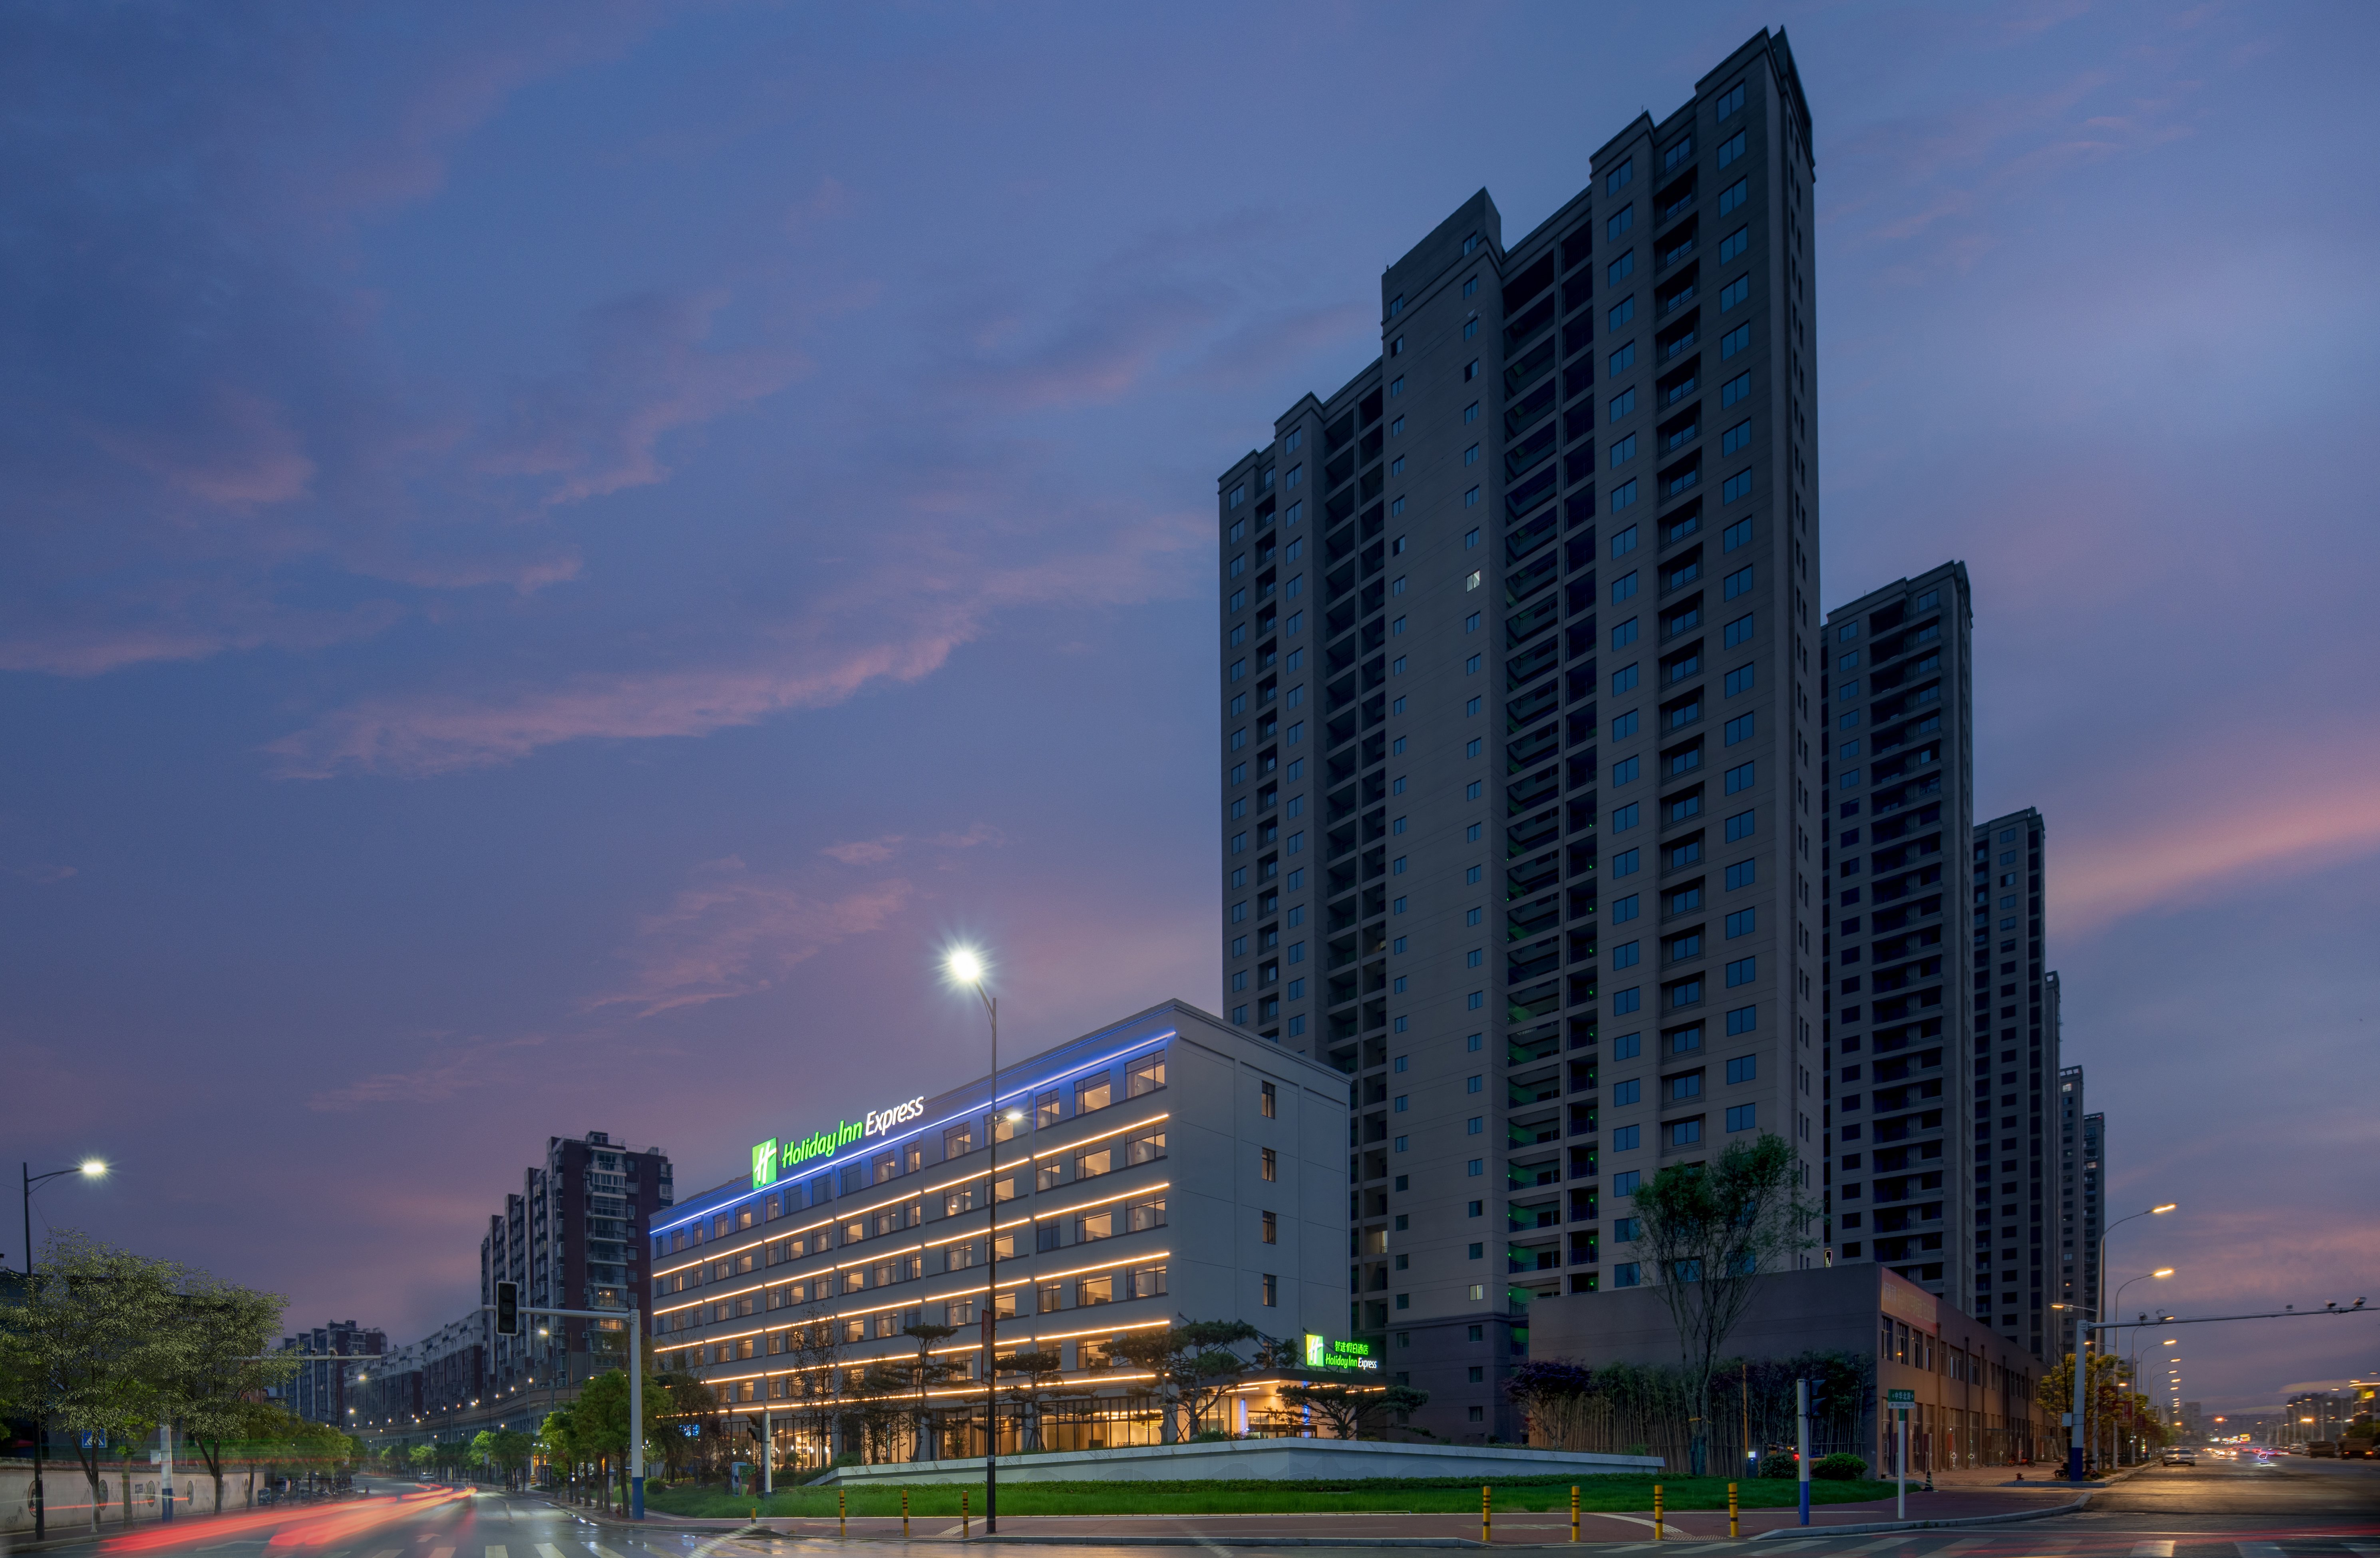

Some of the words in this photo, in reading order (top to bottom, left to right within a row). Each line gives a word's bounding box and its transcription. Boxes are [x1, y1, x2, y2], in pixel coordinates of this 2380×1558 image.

[782, 1131, 837, 1168] Holiday
[838, 1120, 863, 1147] Inn
[865, 1096, 924, 1136] Express
[1334, 1340, 1368, 1355] 智选假日酒店
[1325, 1353, 1348, 1369] Holiday
[1348, 1355, 1357, 1367] Inn
[1358, 1357, 1377, 1370] Express
